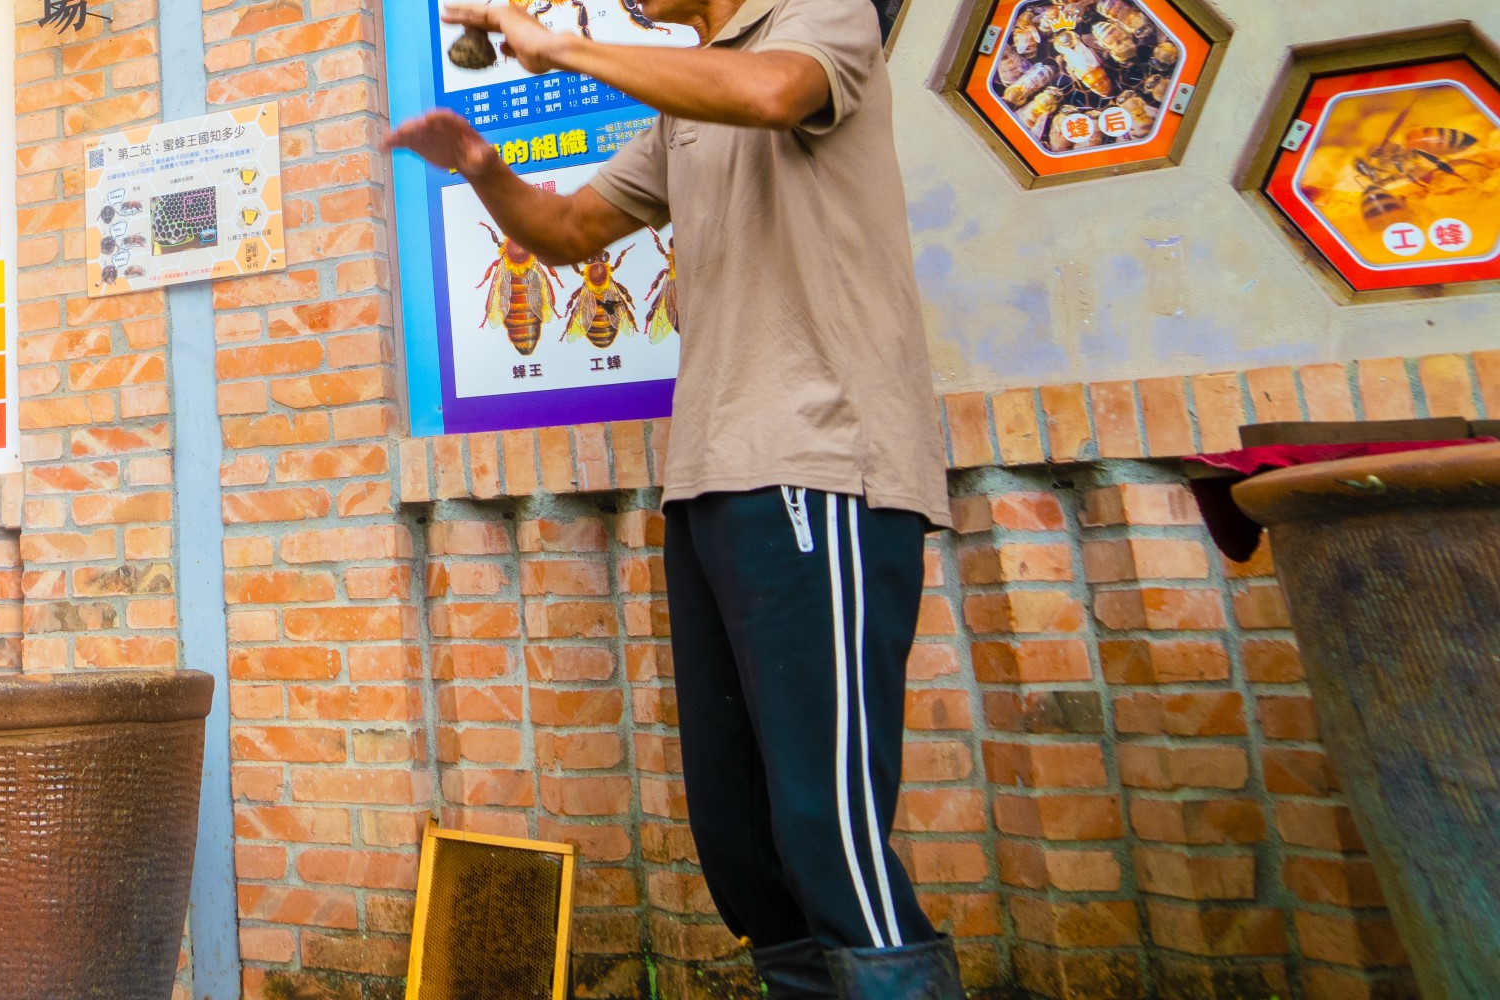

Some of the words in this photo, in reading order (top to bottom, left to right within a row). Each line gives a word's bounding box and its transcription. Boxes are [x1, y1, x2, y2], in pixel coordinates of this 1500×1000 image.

[543, 78, 560, 89] 氣門
[580, 83, 597, 94] 後足
[510, 84, 527, 95] 胸部
[472, 91, 489, 101] 頭部
[543, 90, 561, 101] 腹部
[582, 95, 599, 106] 中足
[511, 97, 528, 107] 前翅
[473, 103, 490, 113] 單眼
[545, 103, 562, 113] 氣門
[474, 114, 499, 125] 翅基片
[512, 109, 529, 119] 後翅
[1067, 111, 1127, 138] 蜂后
[117, 124, 246, 161] 第二站:蜜蜂王國知多少
[1390, 223, 1465, 250] 工蜂
[590, 355, 622, 372] 工蜂
[512, 363, 543, 379] 蜂王
